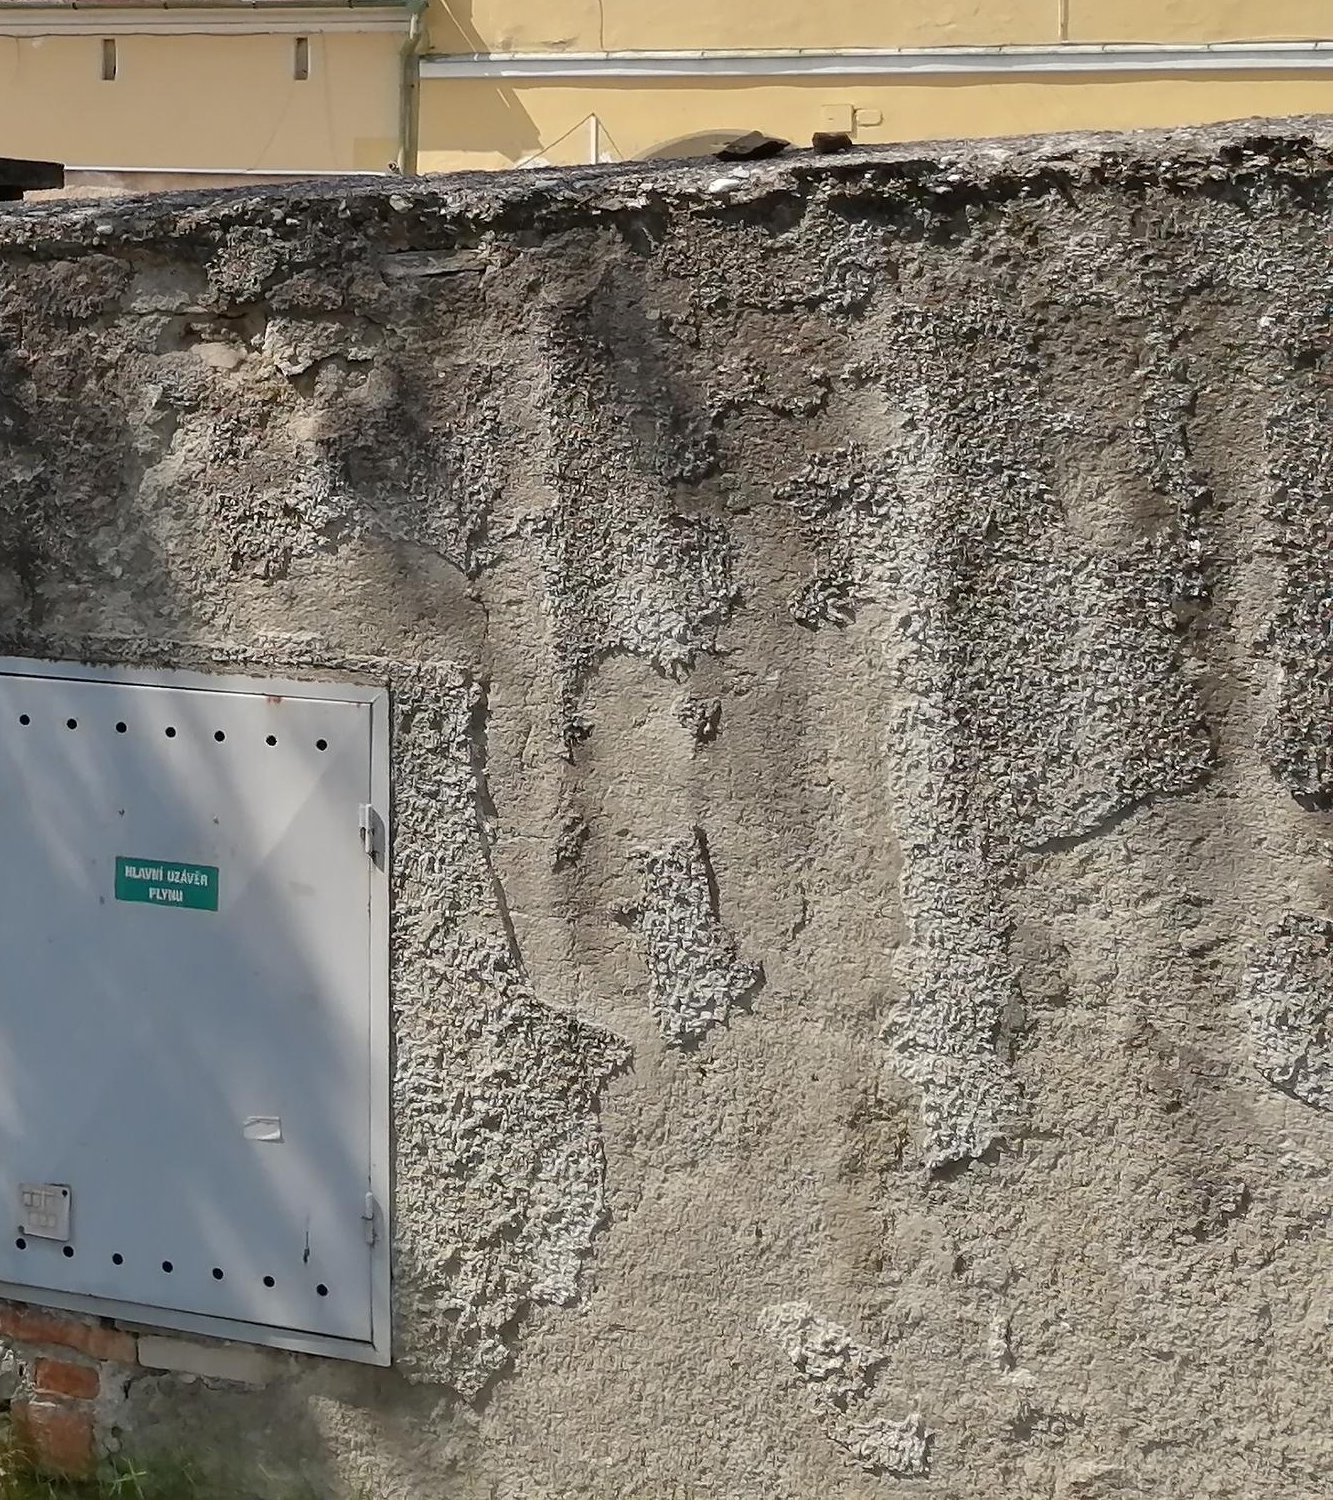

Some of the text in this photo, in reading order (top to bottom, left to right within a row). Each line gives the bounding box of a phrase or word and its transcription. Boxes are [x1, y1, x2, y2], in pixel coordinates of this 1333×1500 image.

[125, 866, 208, 886] HLAVNÍ UZÁVĚR
[148, 887, 183, 902] PLYNU
